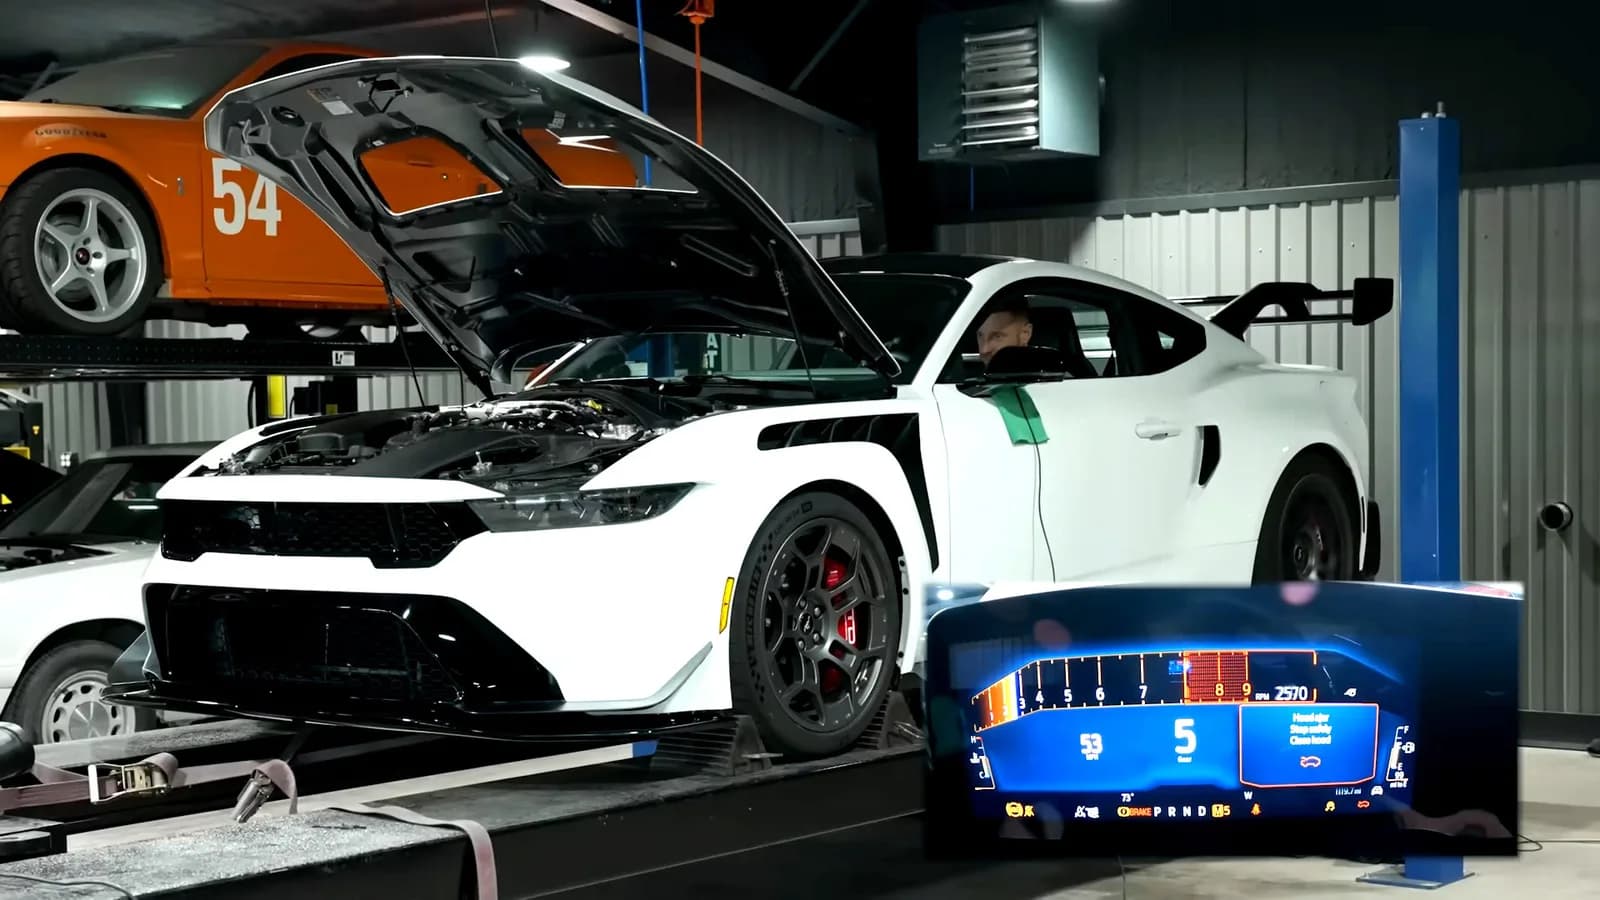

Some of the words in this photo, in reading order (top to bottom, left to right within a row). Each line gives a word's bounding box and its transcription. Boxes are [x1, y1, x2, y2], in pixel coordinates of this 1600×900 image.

[212, 157, 282, 237] 54
[1019, 697, 1026, 709] 3
[1035, 690, 1044, 703] 4
[1063, 688, 1072, 702] 5
[1096, 687, 1105, 701] 6
[1139, 685, 1147, 699] 7
[1215, 683, 1224, 697] 8
[1242, 682, 1251, 696] 9
[1255, 692, 1270, 701] RPM
[1274, 686, 1308, 701] 2570
[1080, 733, 1103, 754] 53
[1174, 718, 1197, 754] 5
[1243, 791, 1253, 800] W
[1129, 806, 1152, 817] BRAKE
[1153, 806, 1161, 817] P
[1167, 806, 1176, 817] R
[1182, 806, 1191, 817] N
[1198, 805, 1207, 817] D
